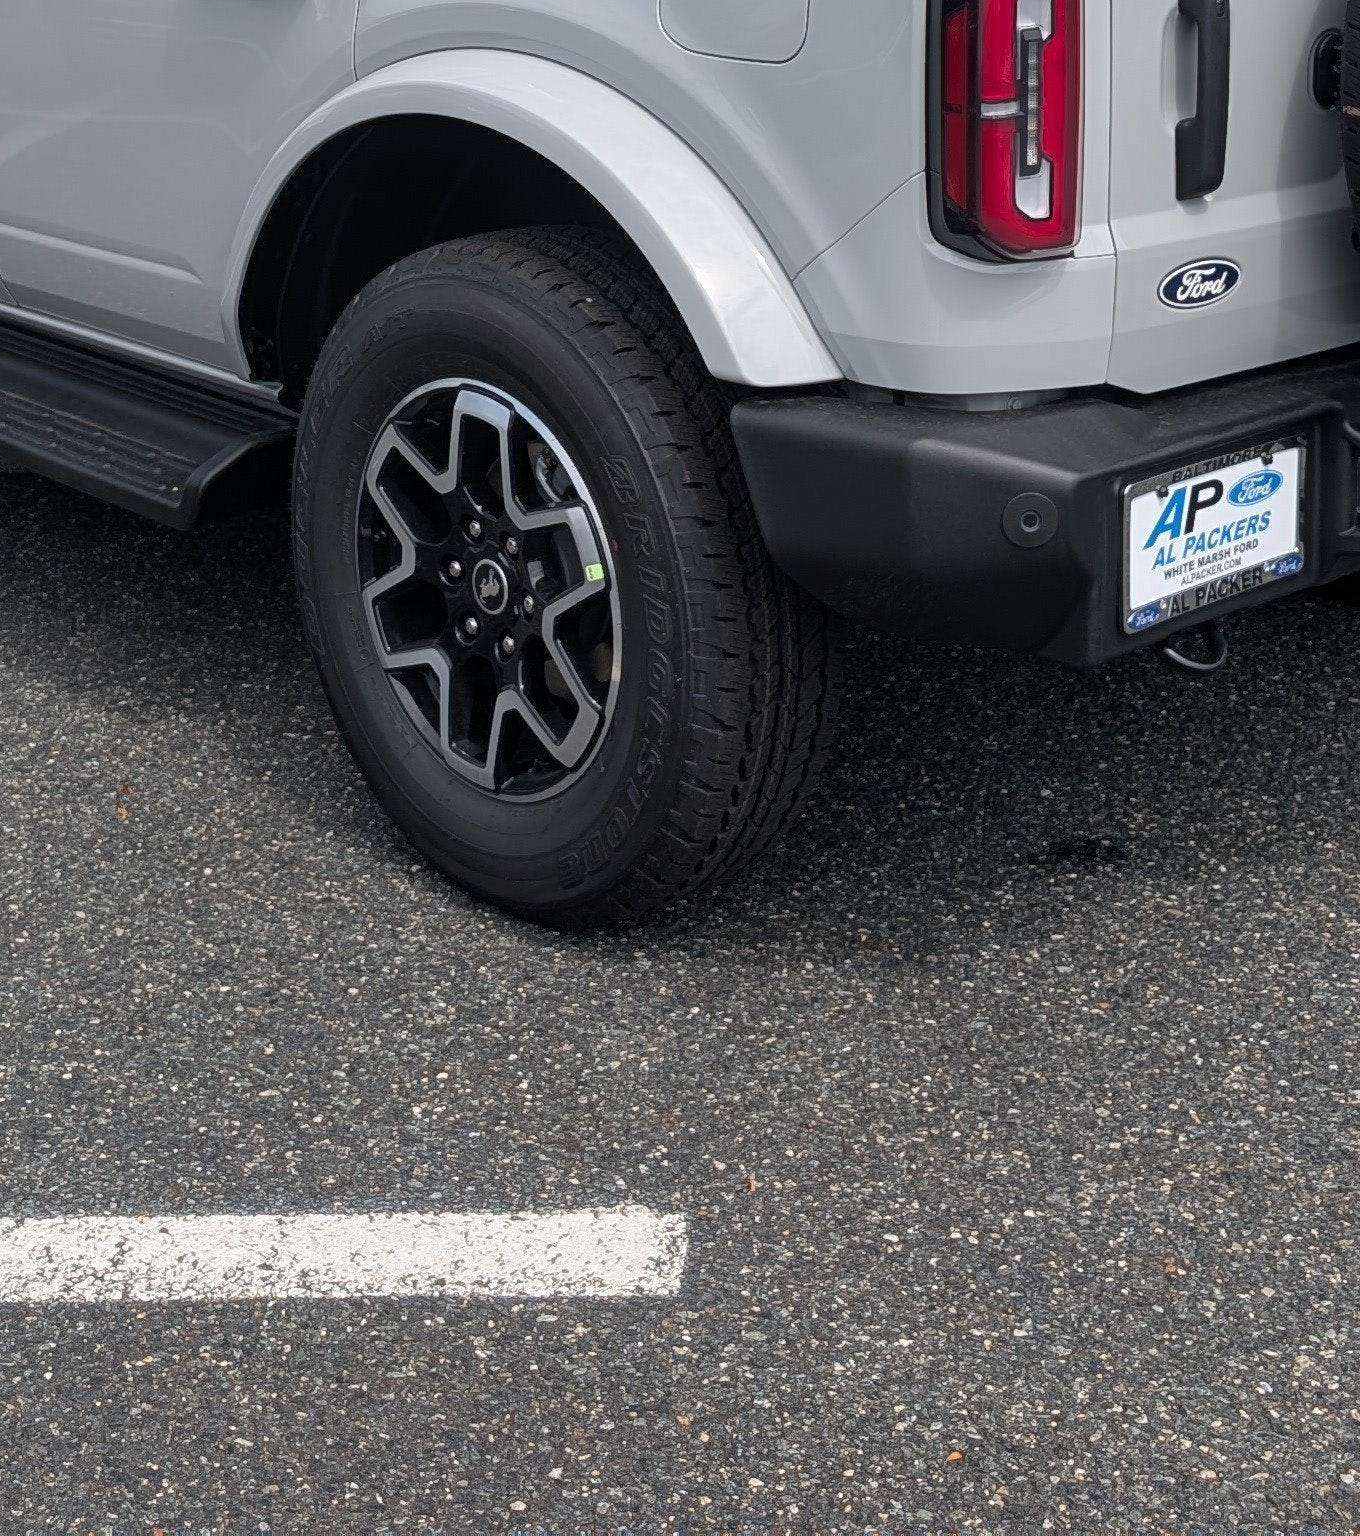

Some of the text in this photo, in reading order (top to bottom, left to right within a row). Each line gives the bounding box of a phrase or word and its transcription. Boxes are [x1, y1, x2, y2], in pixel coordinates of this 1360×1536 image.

[1176, 267, 1228, 301] Ford
[1171, 447, 1264, 483] BALTIMORE
[1238, 473, 1273, 503] Ford
[1142, 479, 1224, 550] AP
[1151, 510, 1272, 570] AL PACKERS
[1164, 538, 1259, 580] WHITE MARSH FORD
[1181, 555, 1242, 586] ALPACKER.COM
[1168, 566, 1264, 617] AL PACKER
